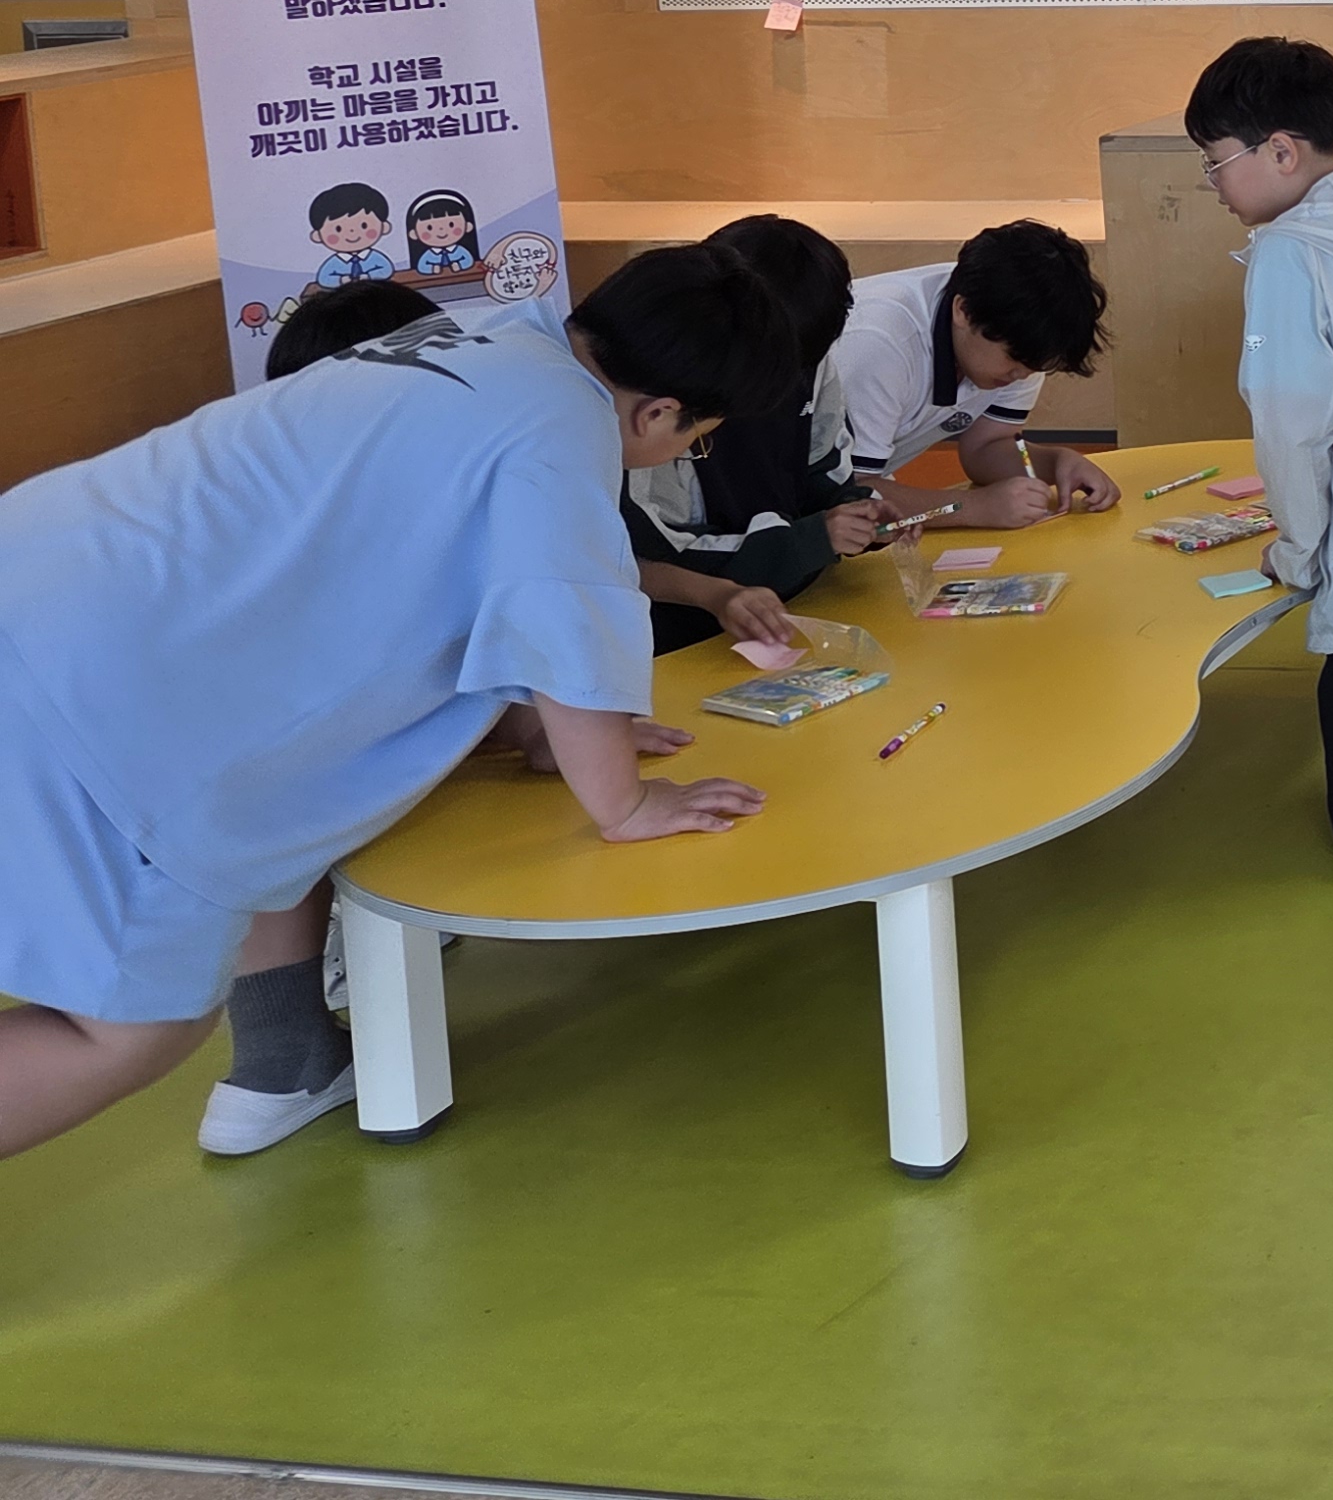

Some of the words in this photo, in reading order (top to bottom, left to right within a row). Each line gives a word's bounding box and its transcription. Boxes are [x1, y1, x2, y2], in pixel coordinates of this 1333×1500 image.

[307, 63, 363, 90] 학교
[369, 56, 443, 86] 시설을
[257, 97, 336, 127] 아끼는
[342, 88, 419, 118] 마음을
[424, 80, 500, 110] 가지고
[248, 127, 328, 159] 깨끗이
[336, 107, 519, 149] 사용하겠습니다.
[507, 247, 547, 263] 친구와
